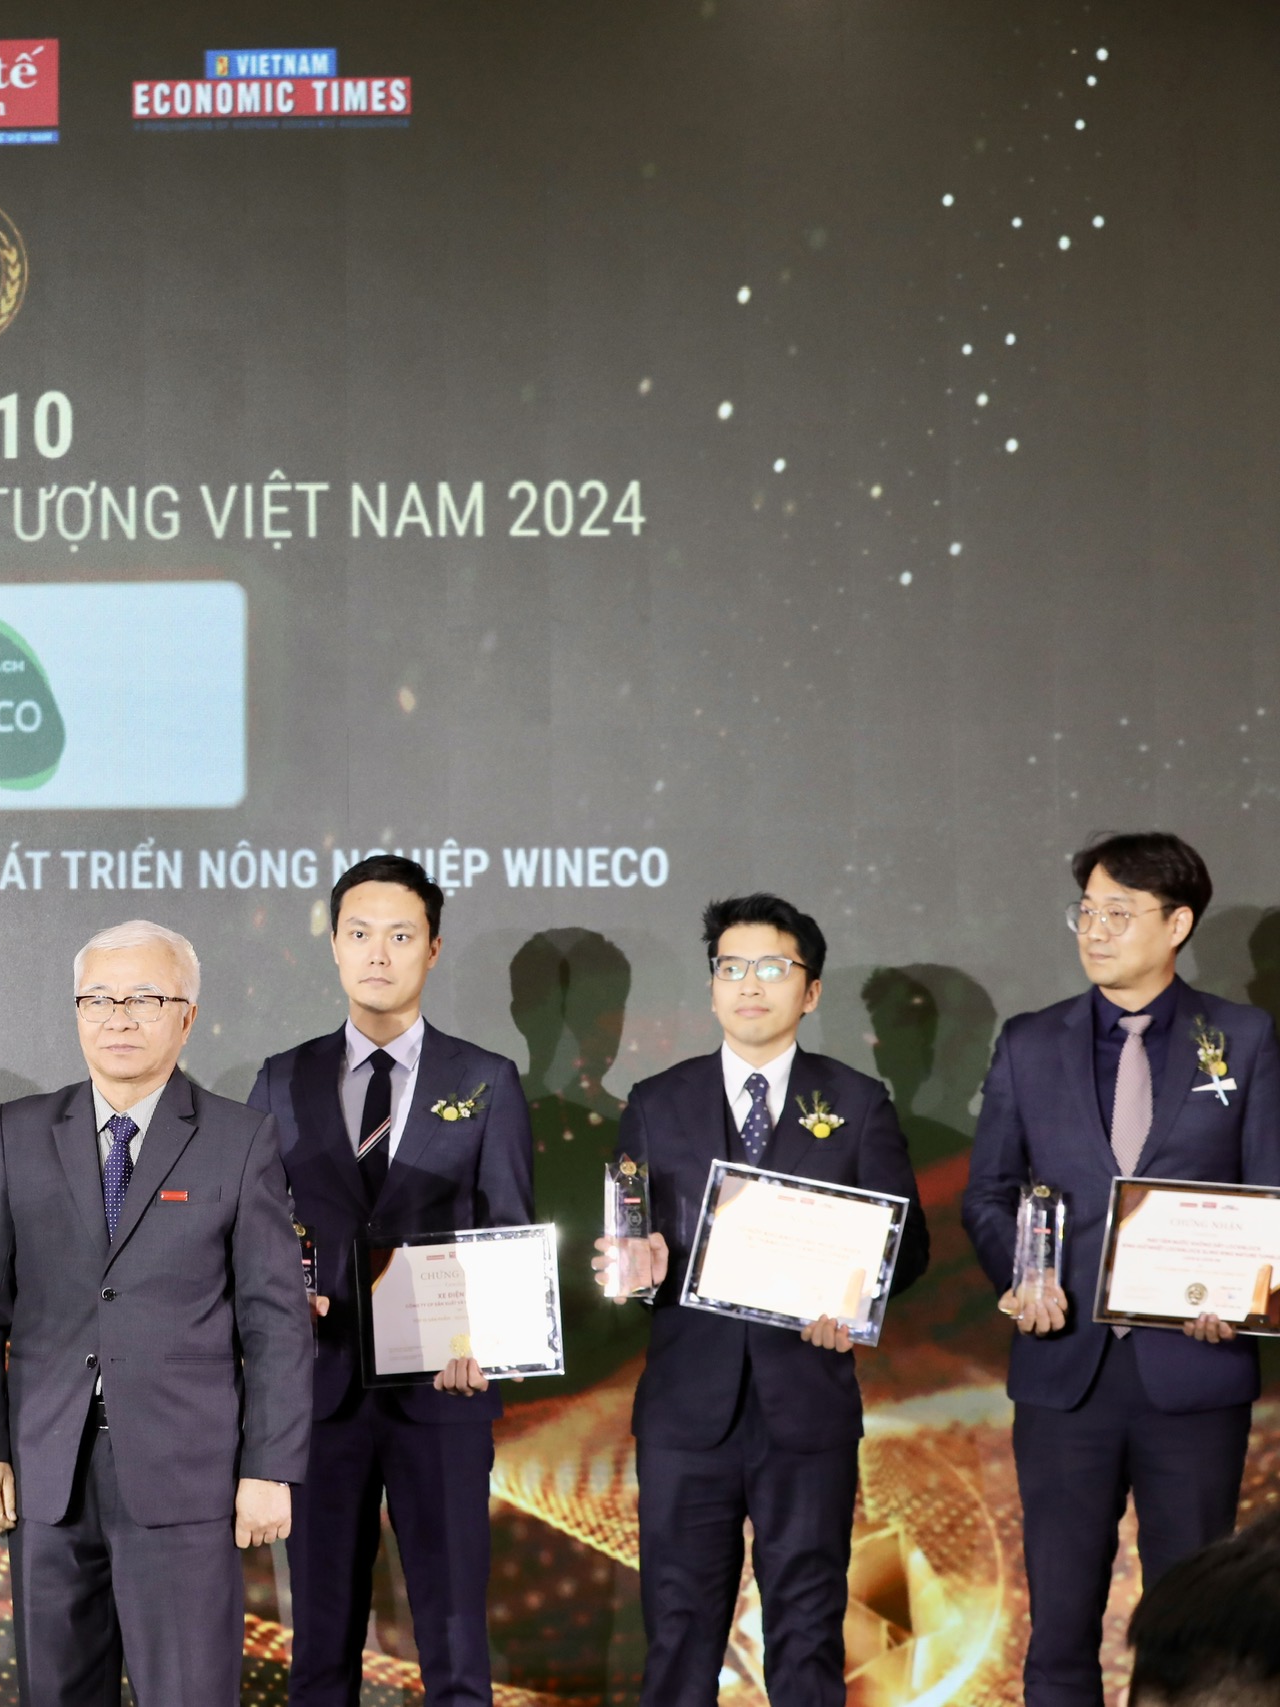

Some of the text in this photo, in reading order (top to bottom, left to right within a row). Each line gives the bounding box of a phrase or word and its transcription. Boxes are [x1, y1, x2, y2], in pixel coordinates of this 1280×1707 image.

[237, 54, 329, 76] VIETNAM
[134, 79, 407, 115] ECONOMIC TIMES
[200, 470, 329, 549] VIỆT
[352, 481, 484, 538] NAM
[508, 480, 646, 537] 2024
[61, 838, 182, 889] TRIỂN
[200, 841, 317, 888] NÔNG
[332, 838, 489, 896] NIỆP
[504, 847, 669, 888] WINECO
